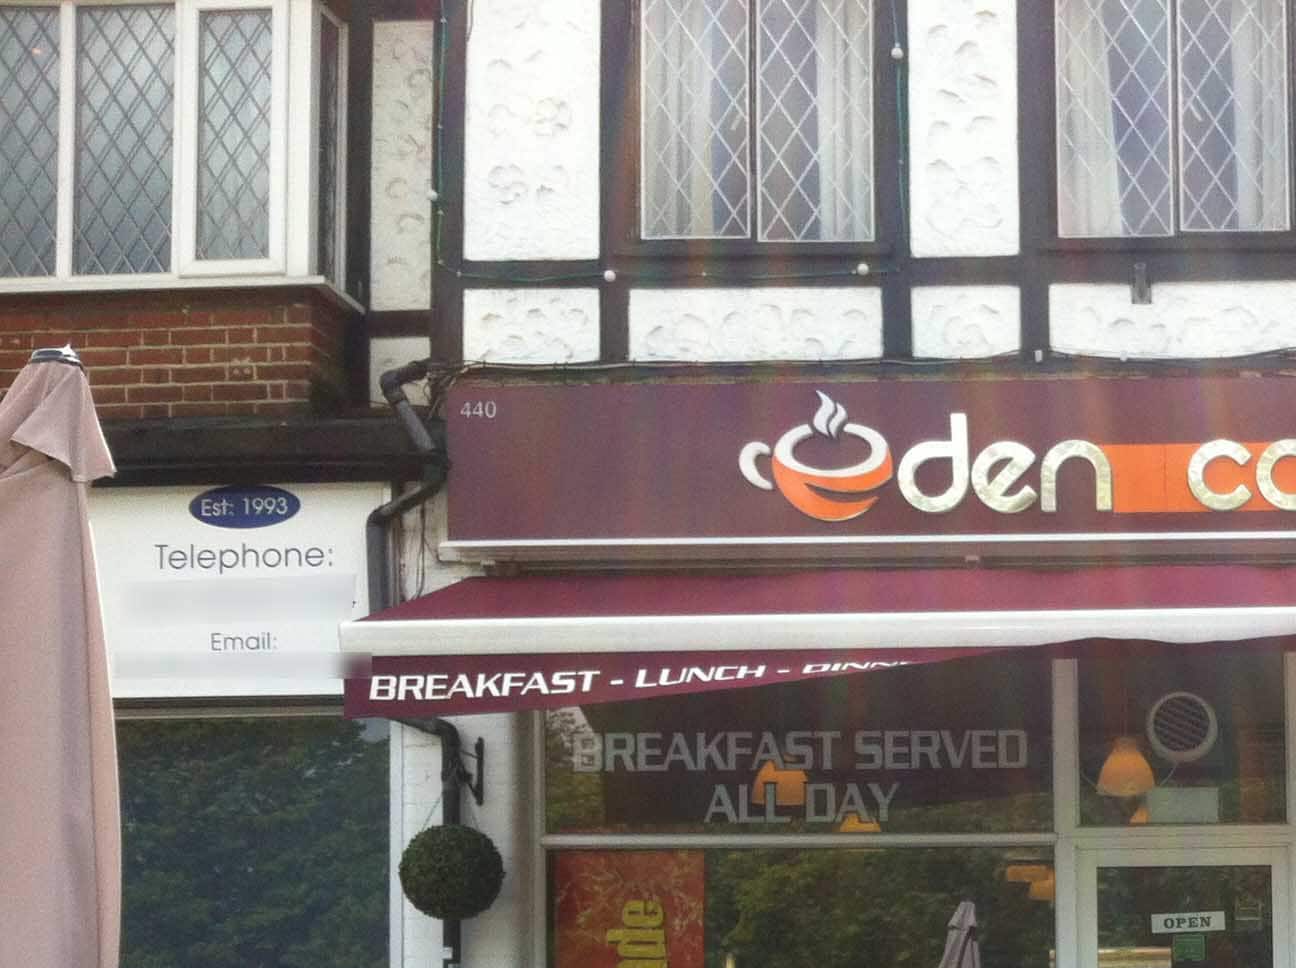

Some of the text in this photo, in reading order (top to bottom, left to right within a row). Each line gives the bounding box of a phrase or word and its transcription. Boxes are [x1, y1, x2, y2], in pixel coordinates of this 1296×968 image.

[460, 401, 497, 419] 440
[242, 497, 289, 515] 1993
[154, 543, 334, 575] Telephone:
[210, 632, 278, 651] Email:
[369, 671, 600, 701] BREAKFAST
[635, 665, 766, 688] LUNCH
[573, 729, 1028, 772] BREAKFAST SERVED
[704, 783, 899, 824] ALL DAY
[1163, 916, 1212, 929] OPEN
